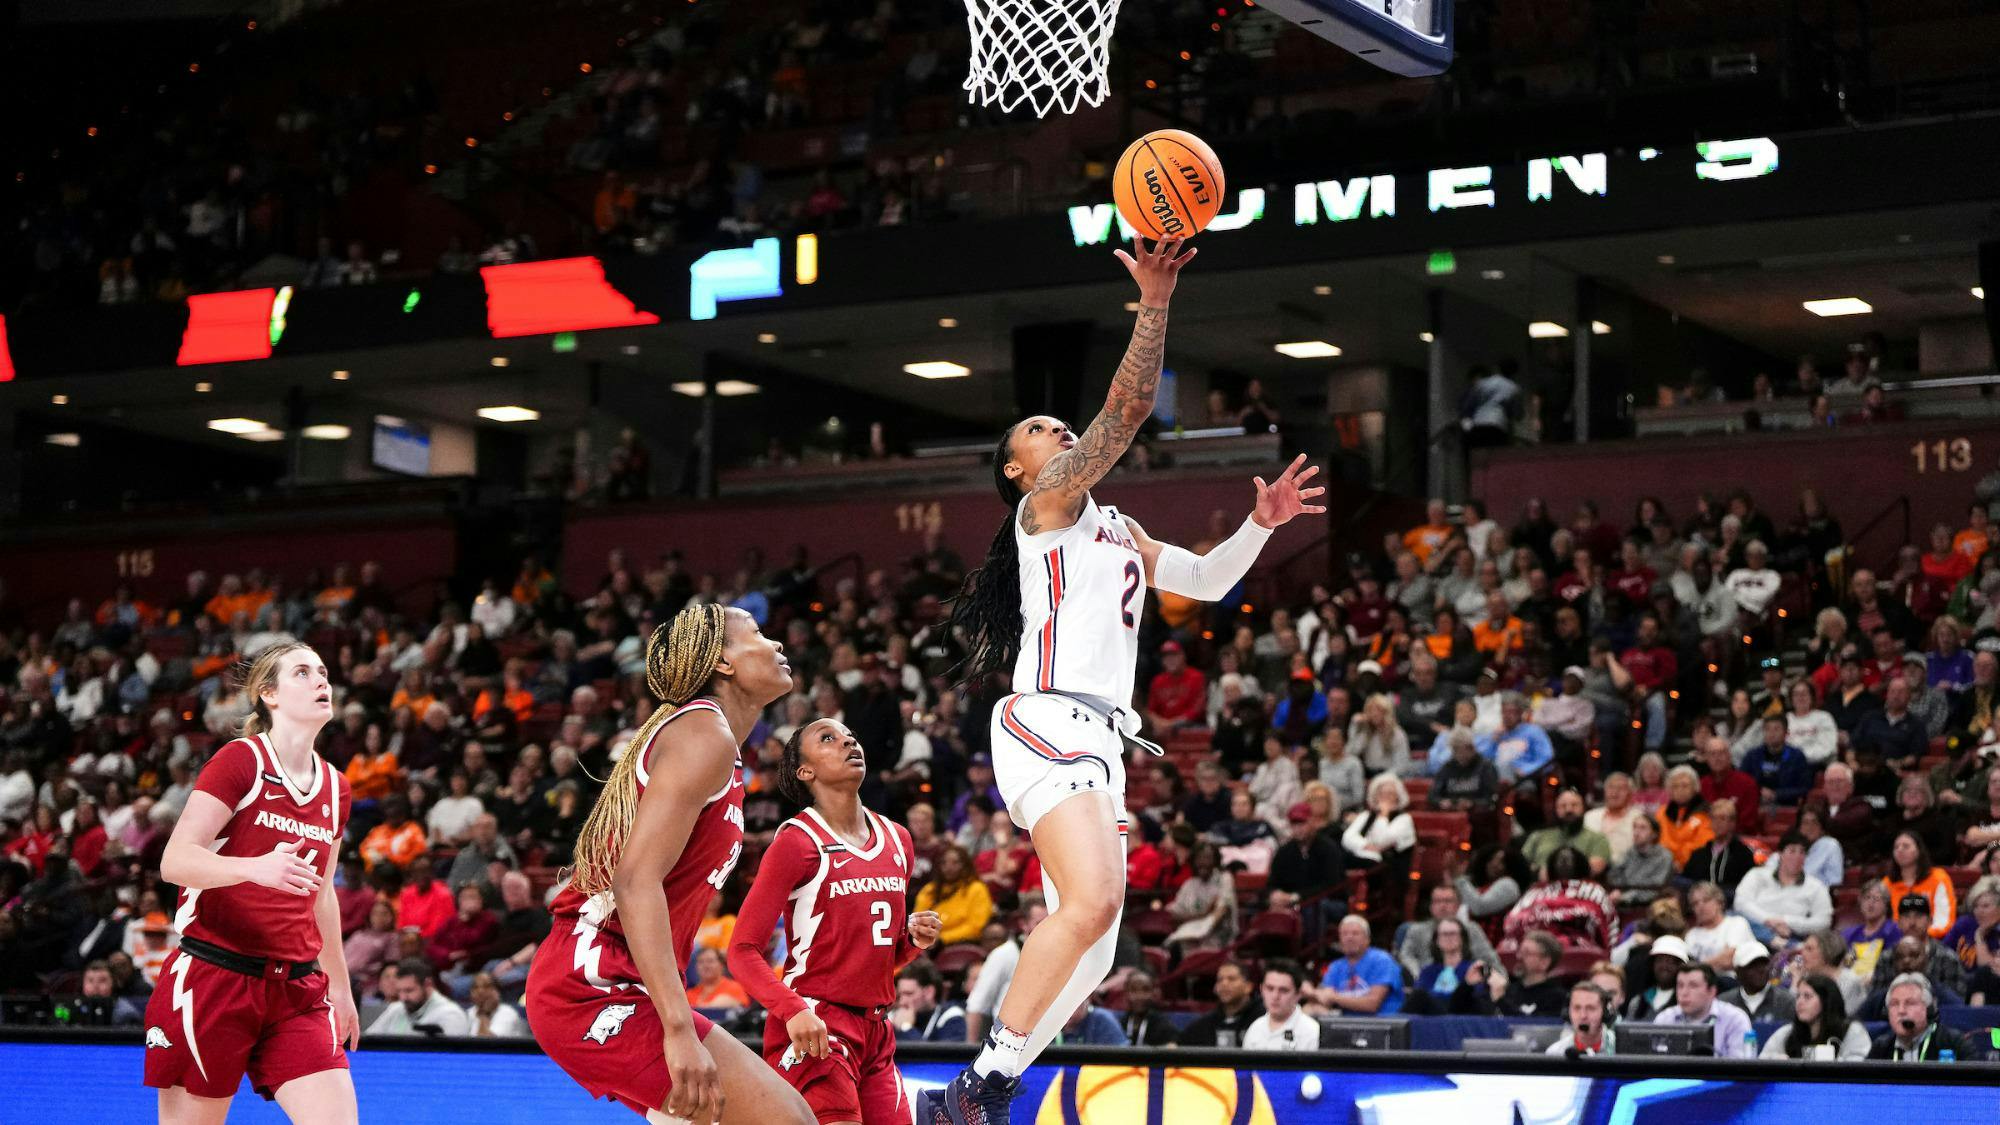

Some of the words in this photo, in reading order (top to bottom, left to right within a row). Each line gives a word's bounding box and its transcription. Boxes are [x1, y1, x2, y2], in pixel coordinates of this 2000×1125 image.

[1144, 167, 1186, 236] Wilson
[1910, 437, 1972, 474] 113
[894, 502, 943, 533] 114
[1121, 559, 1140, 629] 2
[253, 810, 335, 846] ARKANSAS
[870, 900, 893, 947] 2
